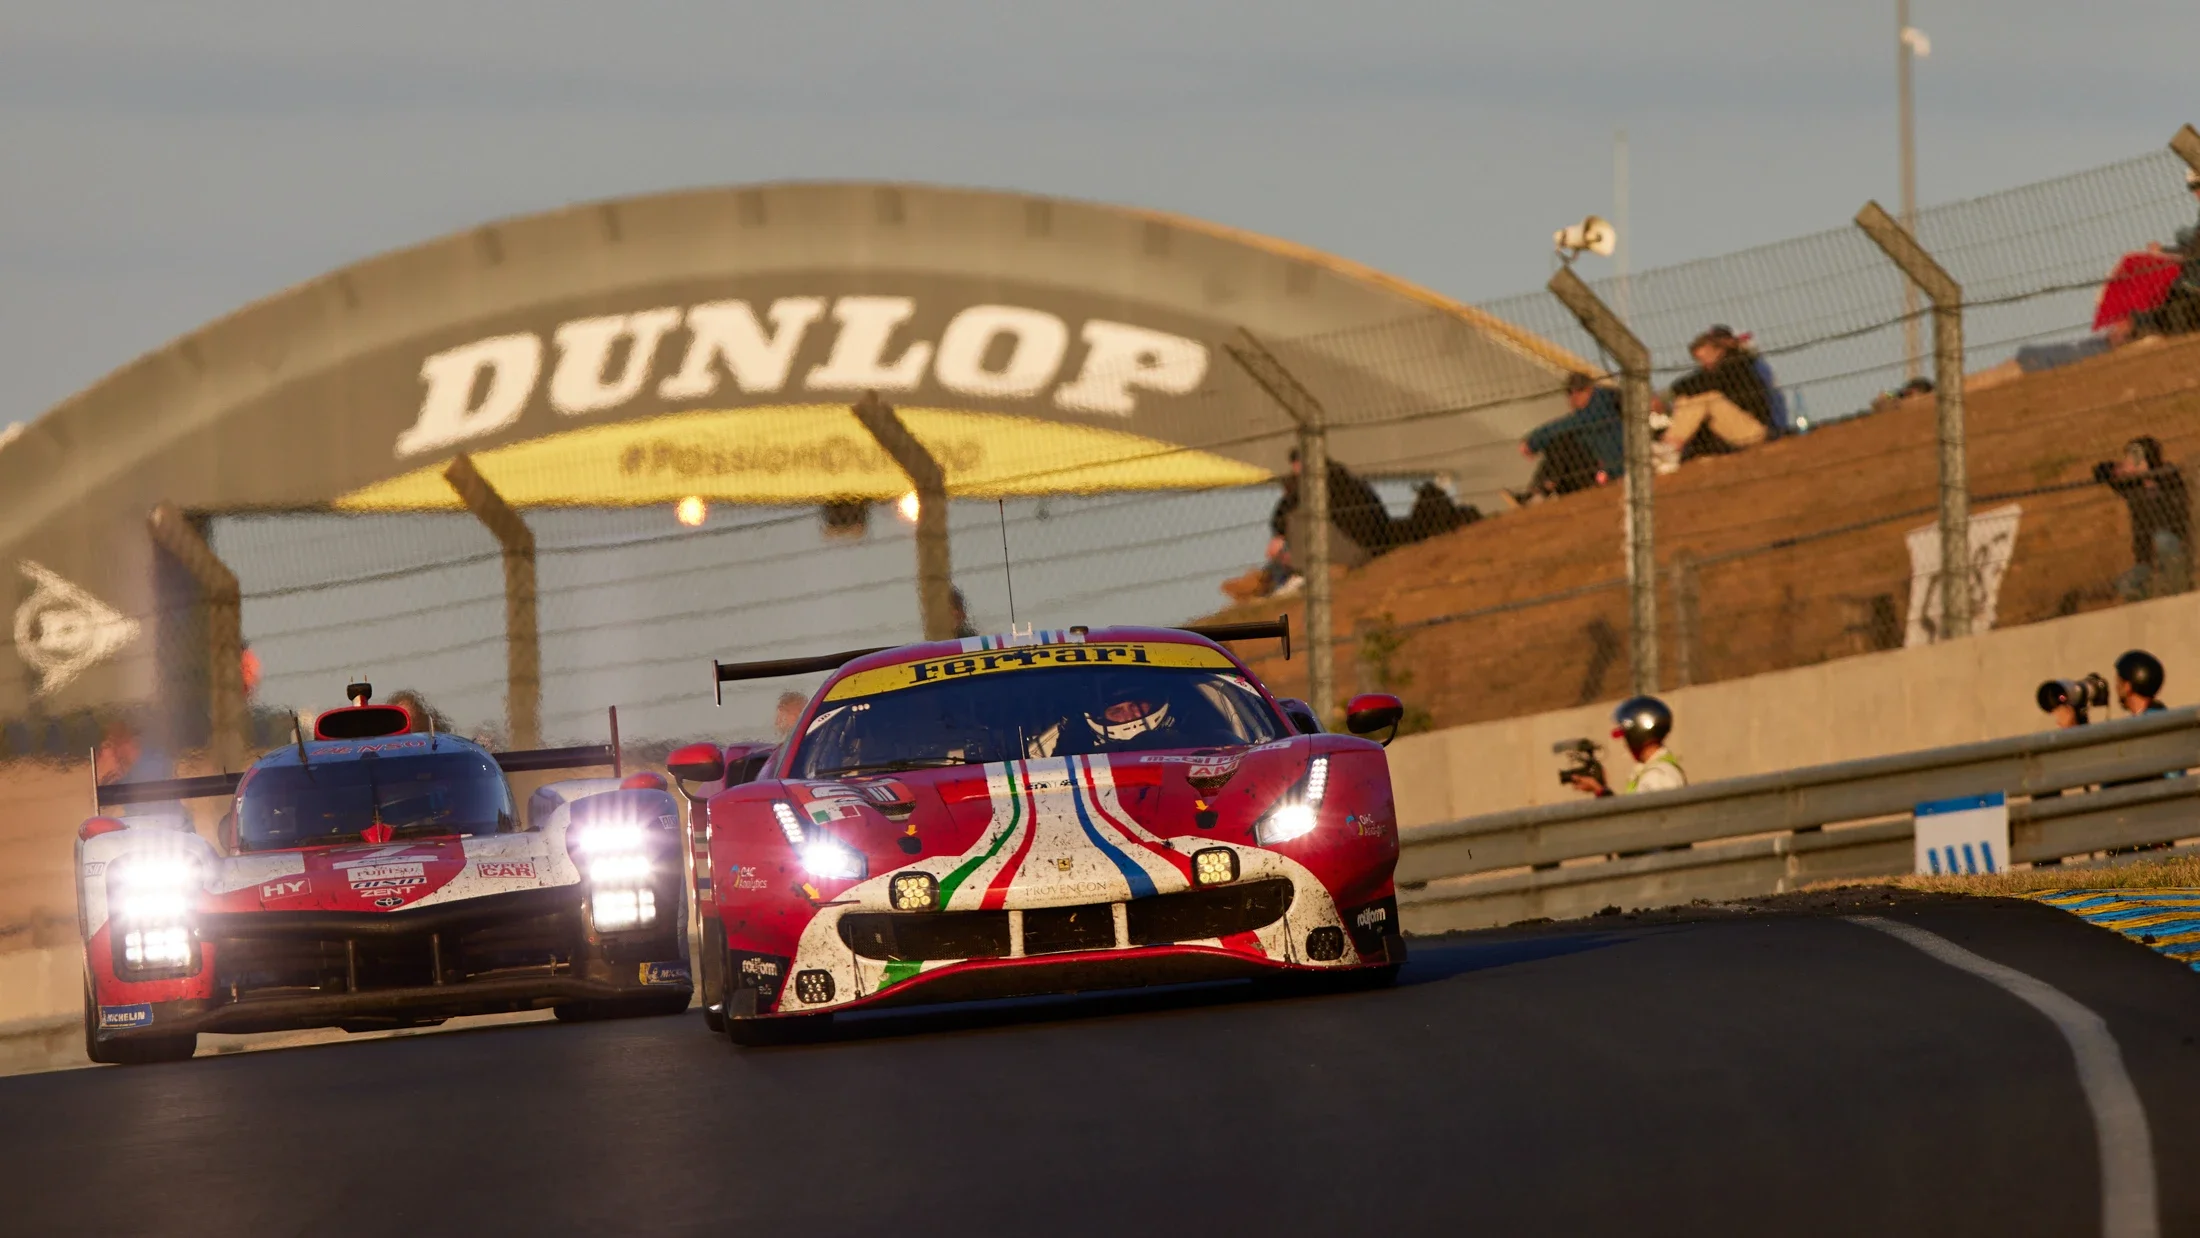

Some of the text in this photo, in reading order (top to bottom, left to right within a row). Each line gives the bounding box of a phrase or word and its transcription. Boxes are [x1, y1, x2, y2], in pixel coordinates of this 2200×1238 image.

[395, 296, 1209, 459] DUNLOP
[908, 644, 1151, 684] Ferrari
[1193, 761, 1238, 776] AM
[482, 867, 532, 877] CAR
[263, 880, 306, 898] HY
[360, 886, 416, 897] ZENT
[1025, 881, 1107, 896] PROVENCON
[106, 1011, 145, 1022] MICHELIN
